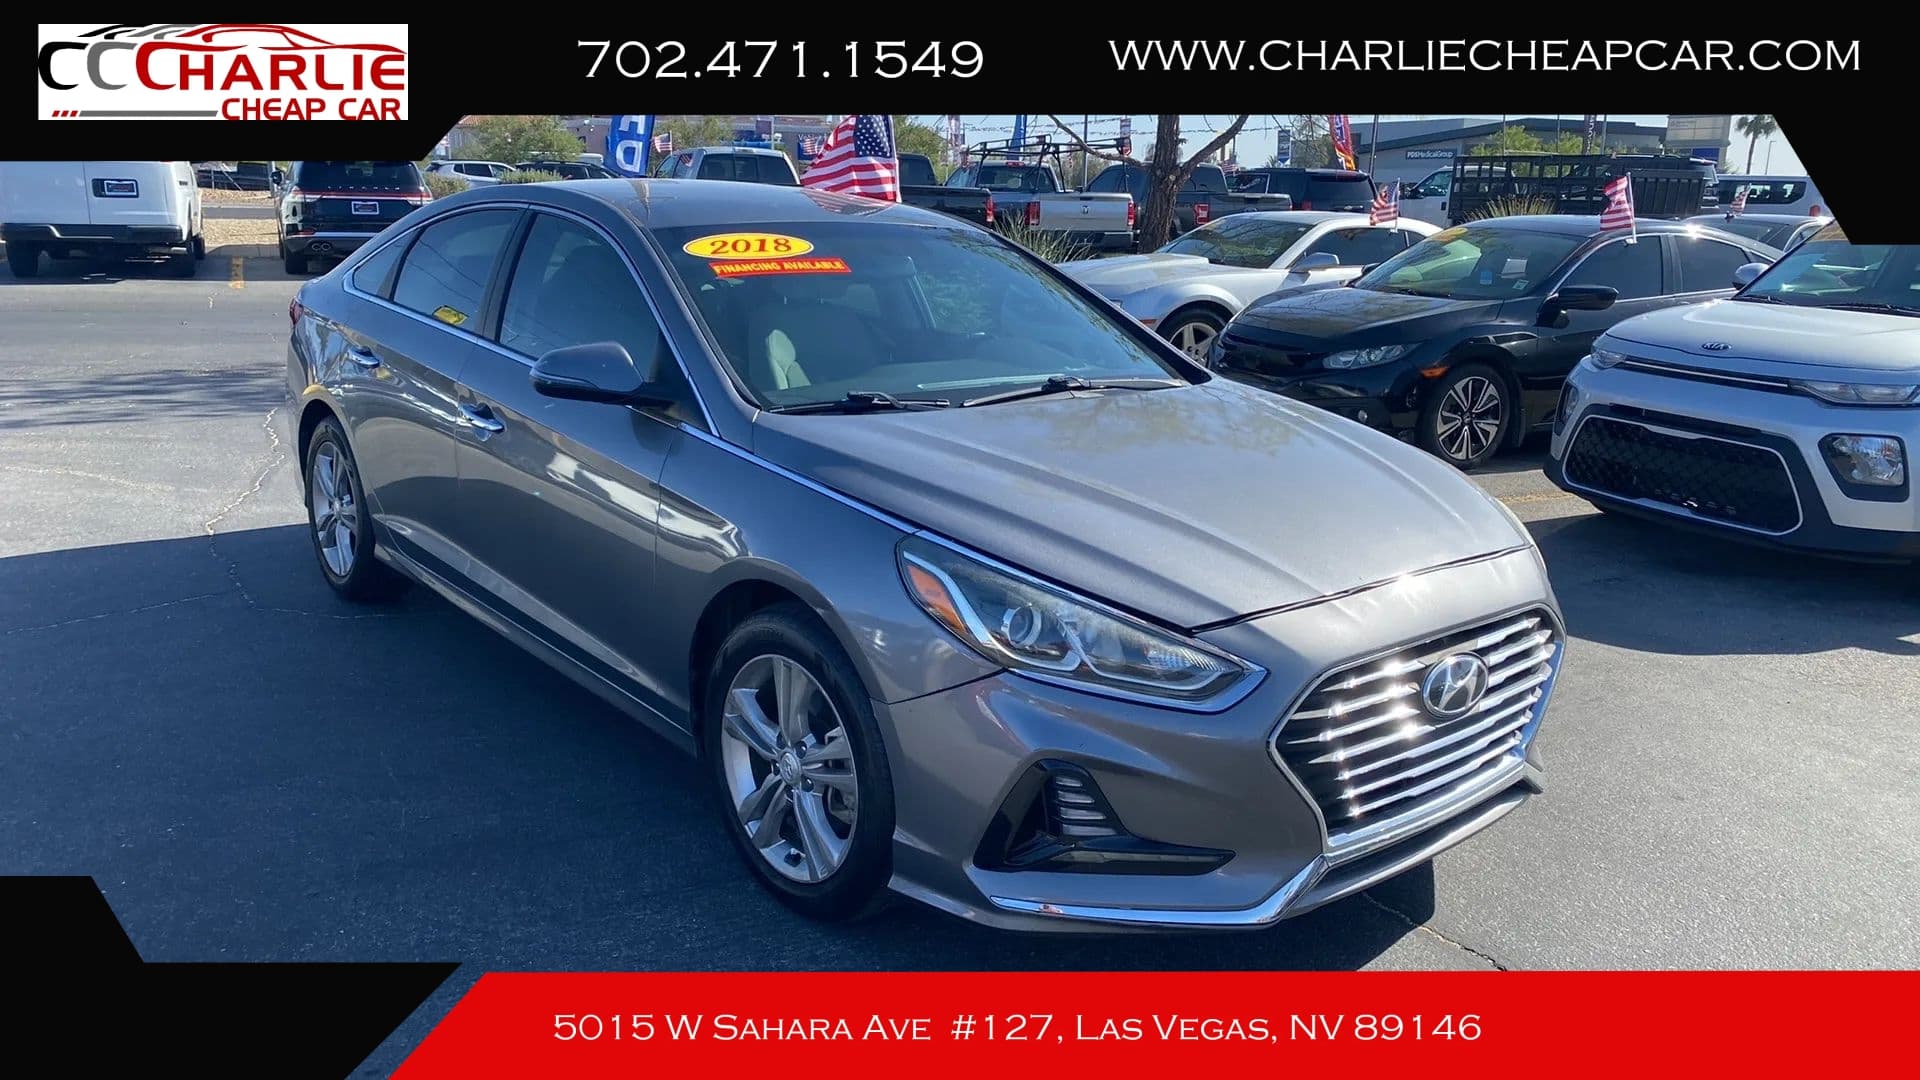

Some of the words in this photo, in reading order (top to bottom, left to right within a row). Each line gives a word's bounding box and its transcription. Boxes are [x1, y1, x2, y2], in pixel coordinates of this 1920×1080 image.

[710, 238, 791, 255] 2018
[714, 263, 782, 274] FINANCING
[783, 261, 845, 270] AVAILABLE
